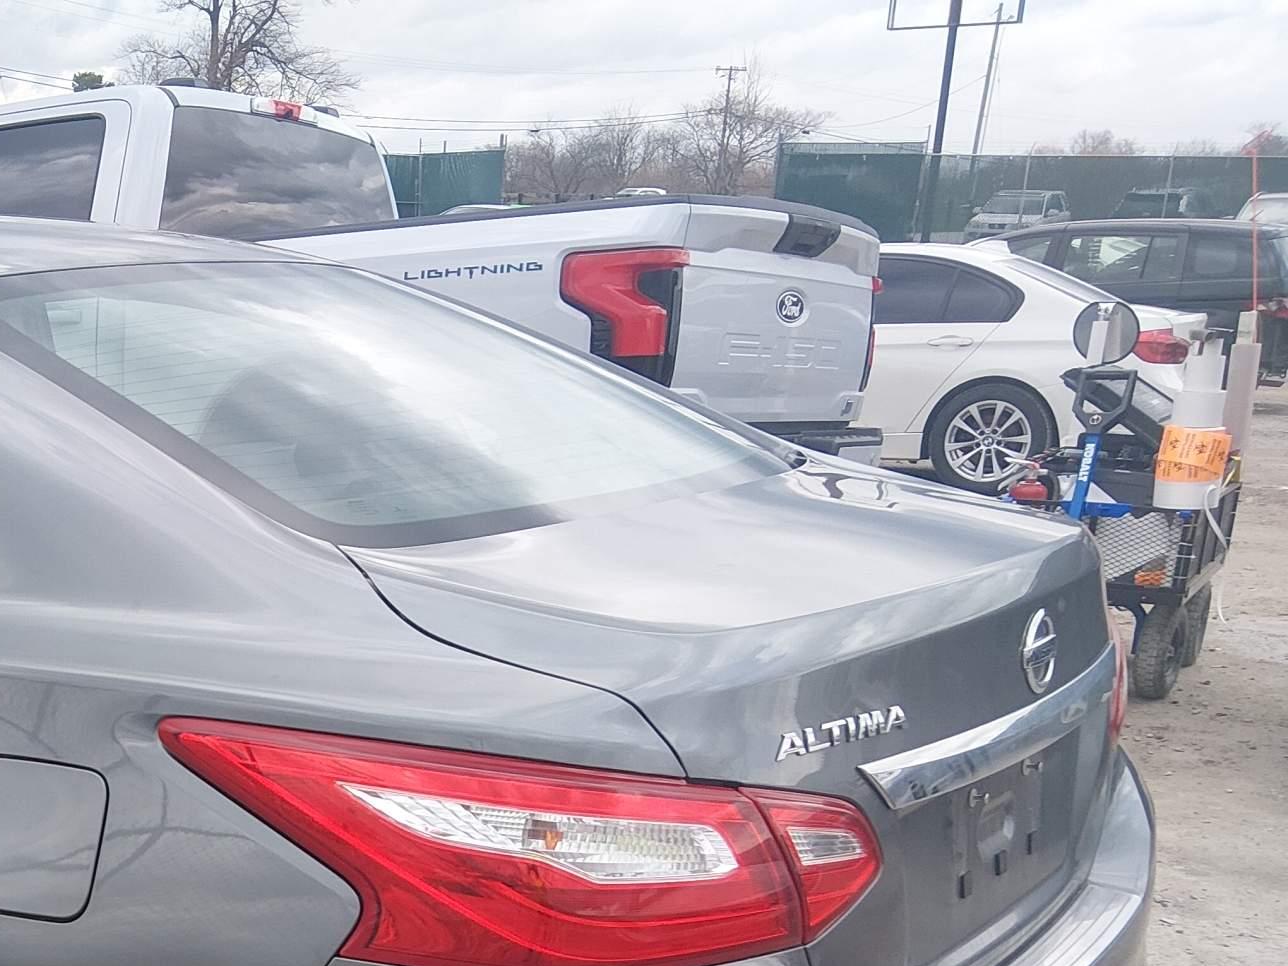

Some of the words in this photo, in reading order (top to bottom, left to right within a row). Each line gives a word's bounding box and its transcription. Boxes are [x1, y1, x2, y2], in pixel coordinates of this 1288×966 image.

[404, 261, 543, 281] LIGHTNING
[1078, 443, 1096, 482] KOBALT
[775, 704, 907, 762] ALTIMA
